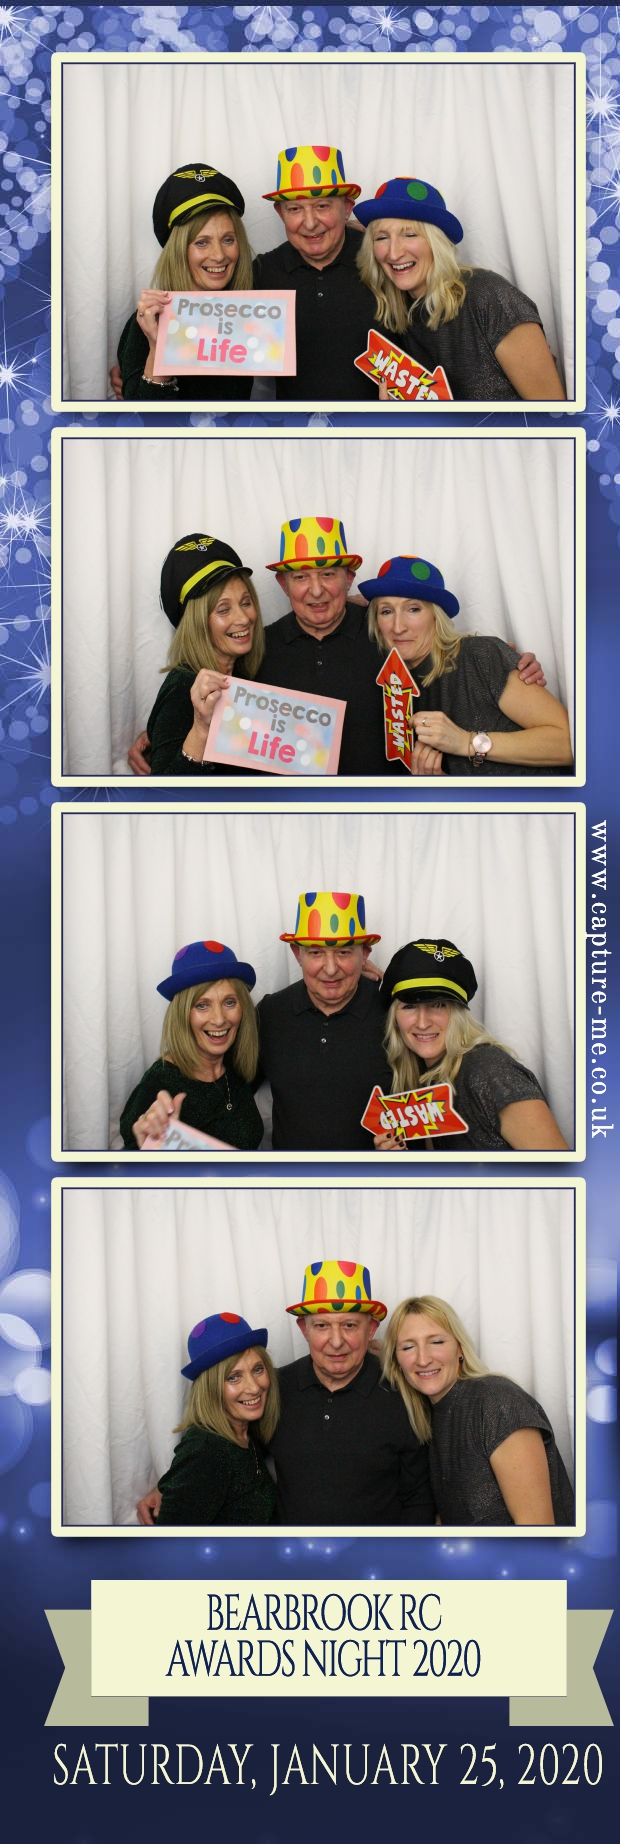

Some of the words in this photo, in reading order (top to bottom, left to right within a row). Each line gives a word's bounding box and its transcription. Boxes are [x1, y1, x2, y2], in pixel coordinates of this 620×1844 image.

[177, 298, 282, 320] Prosecco
[218, 317, 233, 335] is
[197, 338, 248, 363] Life
[233, 685, 332, 727] Prosecco
[390, 673, 405, 748] WASTED
[270, 714, 286, 734] is
[247, 731, 296, 763] Life
[380, 1102, 445, 1130] WASTED
[165, 1129, 202, 1150] Pr
